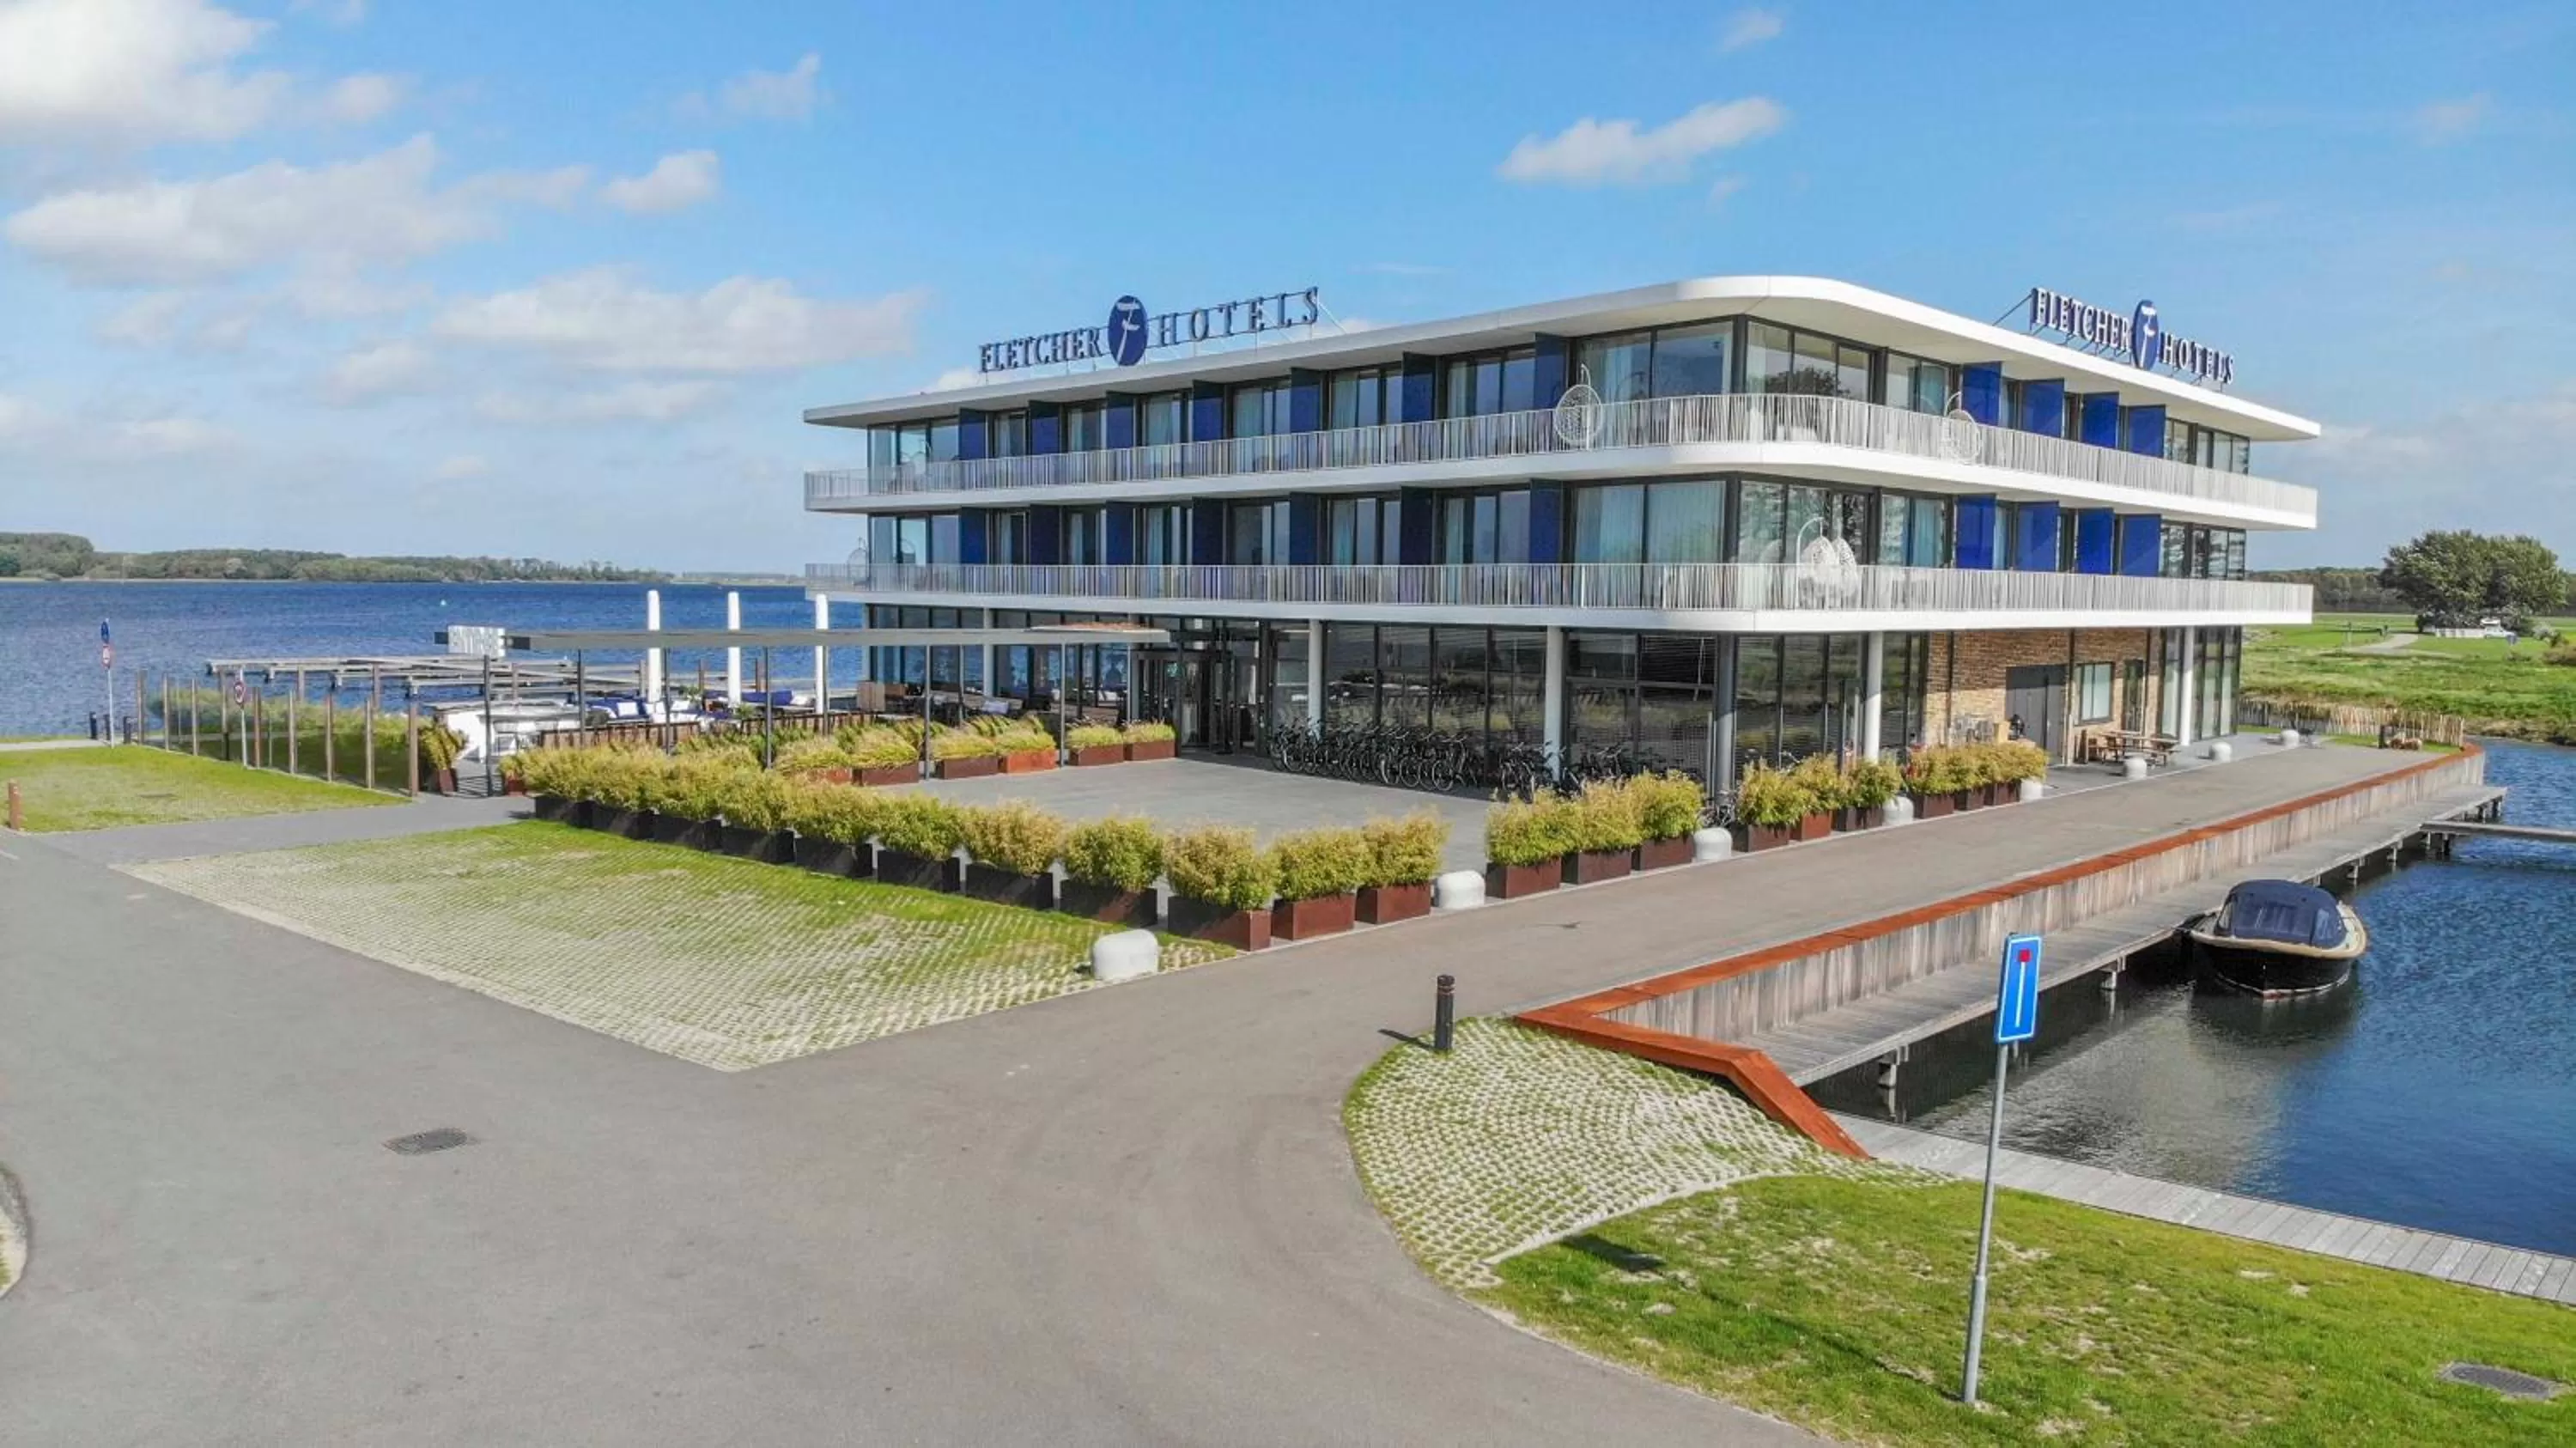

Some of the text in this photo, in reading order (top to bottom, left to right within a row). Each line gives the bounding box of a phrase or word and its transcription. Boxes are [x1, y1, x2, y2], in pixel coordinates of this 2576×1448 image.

[980, 326, 1104, 372] FLETCHER
[1159, 286, 1319, 348] HOTELS
[2031, 288, 2133, 353] FLETCHER
[2160, 332, 2234, 384] HOTELS
